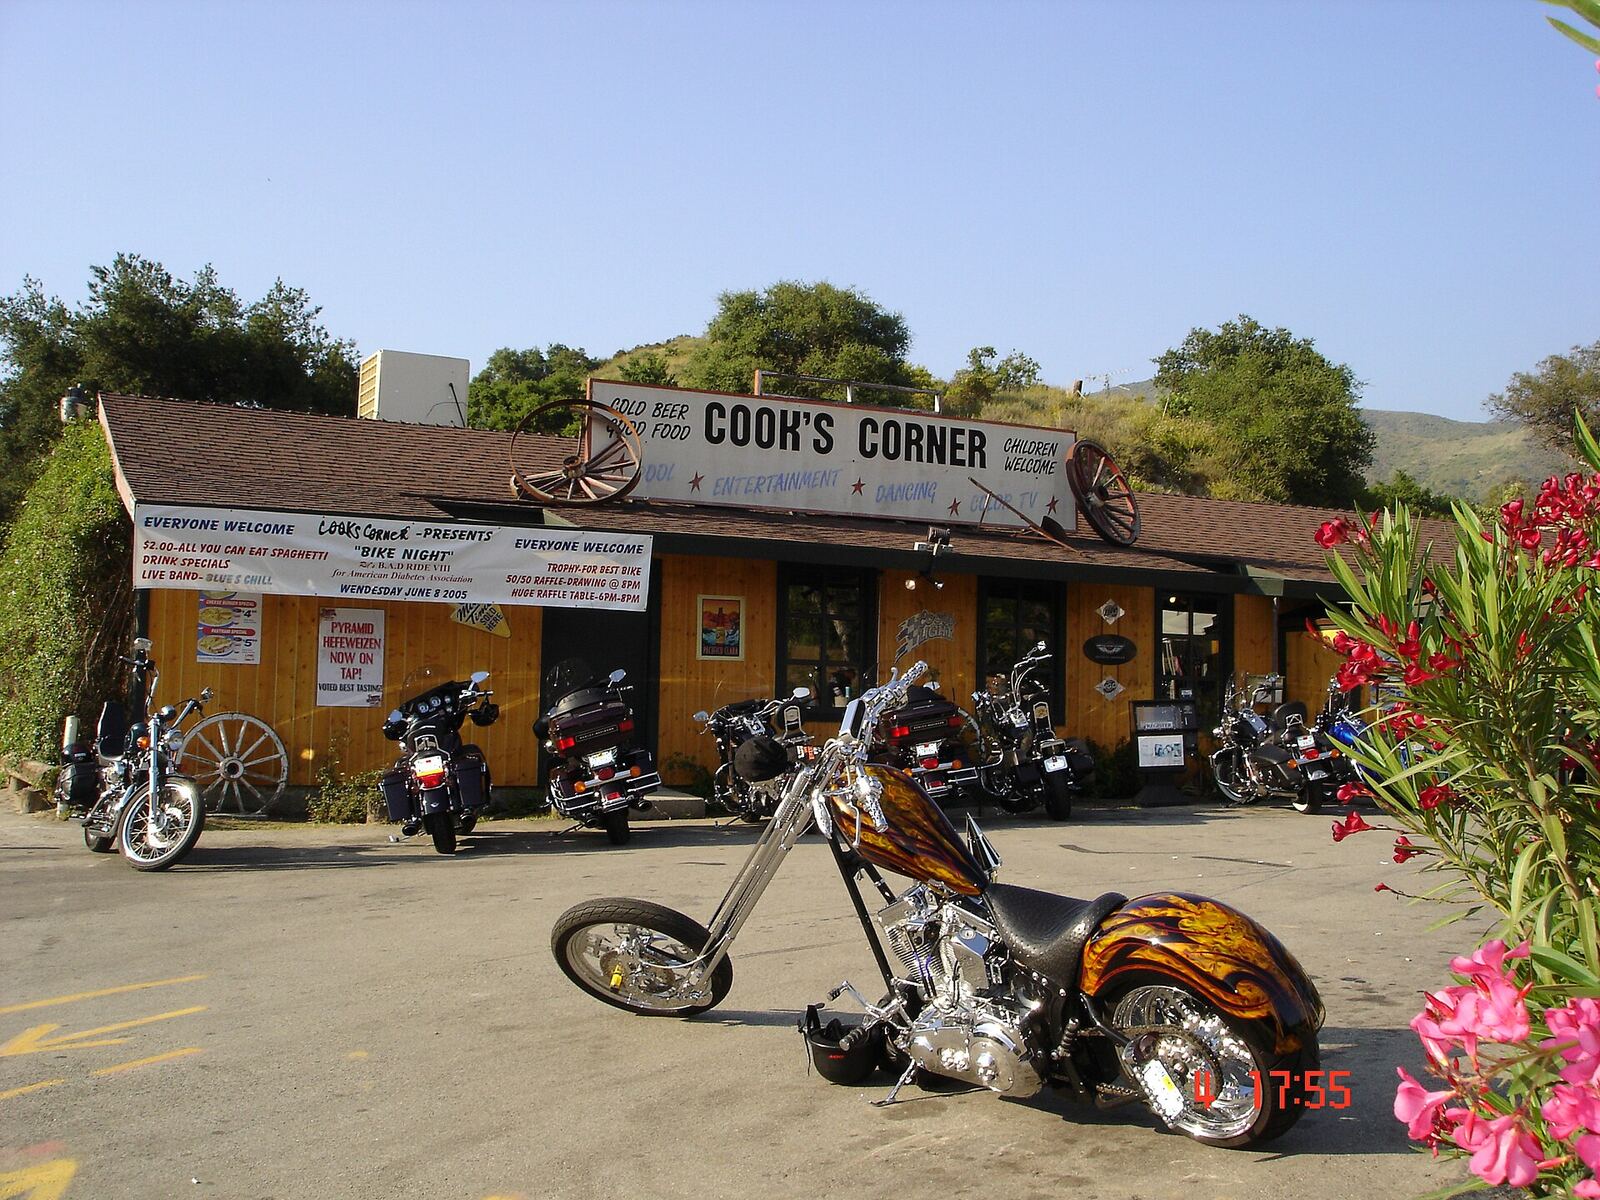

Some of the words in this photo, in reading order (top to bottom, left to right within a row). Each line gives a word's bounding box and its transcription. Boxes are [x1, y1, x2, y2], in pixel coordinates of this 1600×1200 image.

[610, 397, 647, 416] COLD
[652, 402, 690, 420] BEER
[651, 422, 692, 441] FOOD
[704, 401, 835, 455] COOK'S
[858, 417, 988, 469] CORNER
[1003, 437, 1059, 458] CHILDREN
[639, 462, 676, 483] OOL
[1003, 456, 1058, 476] WELCOME
[712, 468, 843, 497] ENTERTAINMENT
[875, 481, 938, 504] DANCING
[1019, 490, 1039, 509] TV
[143, 516, 220, 532] EVERYONE
[223, 520, 296, 536] WELCOME
[142, 540, 198, 554] $2.00-ALL
[199, 543, 222, 555] YOU
[223, 544, 246, 556] CAN
[248, 546, 269, 557] EAT
[270, 547, 329, 561] SPAGHETTI
[514, 538, 580, 552] EVERYONE
[583, 541, 645, 555] WELCOME
[142, 554, 179, 567] DRINK
[180, 557, 231, 570] SPECIALS
[406, 562, 431, 572] RIDE
[547, 562, 598, 575] TROPHY-FOR
[599, 564, 620, 575] BEST
[621, 566, 642, 576] BIKE
[141, 569, 167, 581] LIVE
[244, 574, 273, 586] CHILL
[331, 568, 347, 579] for
[348, 569, 389, 580] American
[390, 571, 426, 582] Diabetes
[428, 572, 473, 584] Association
[505, 574, 532, 586] 50/50
[608, 578, 620, 590] @
[621, 579, 641, 590] 8PM
[339, 583, 404, 597] WENDESDAY
[404, 586, 432, 598] JUNE
[433, 588, 441, 598] 8
[442, 589, 468, 600] 2005
[511, 588, 535, 598] HUGE
[536, 589, 567, 600] RAFFLE
[330, 621, 375, 635] PYRAMID
[323, 636, 382, 650] HEFEWEIZEN
[329, 651, 356, 664] NOW
[359, 652, 374, 665] ON
[340, 667, 362, 680] TAP!
[318, 683, 338, 692] VOTED
[339, 683, 356, 693] BEST
